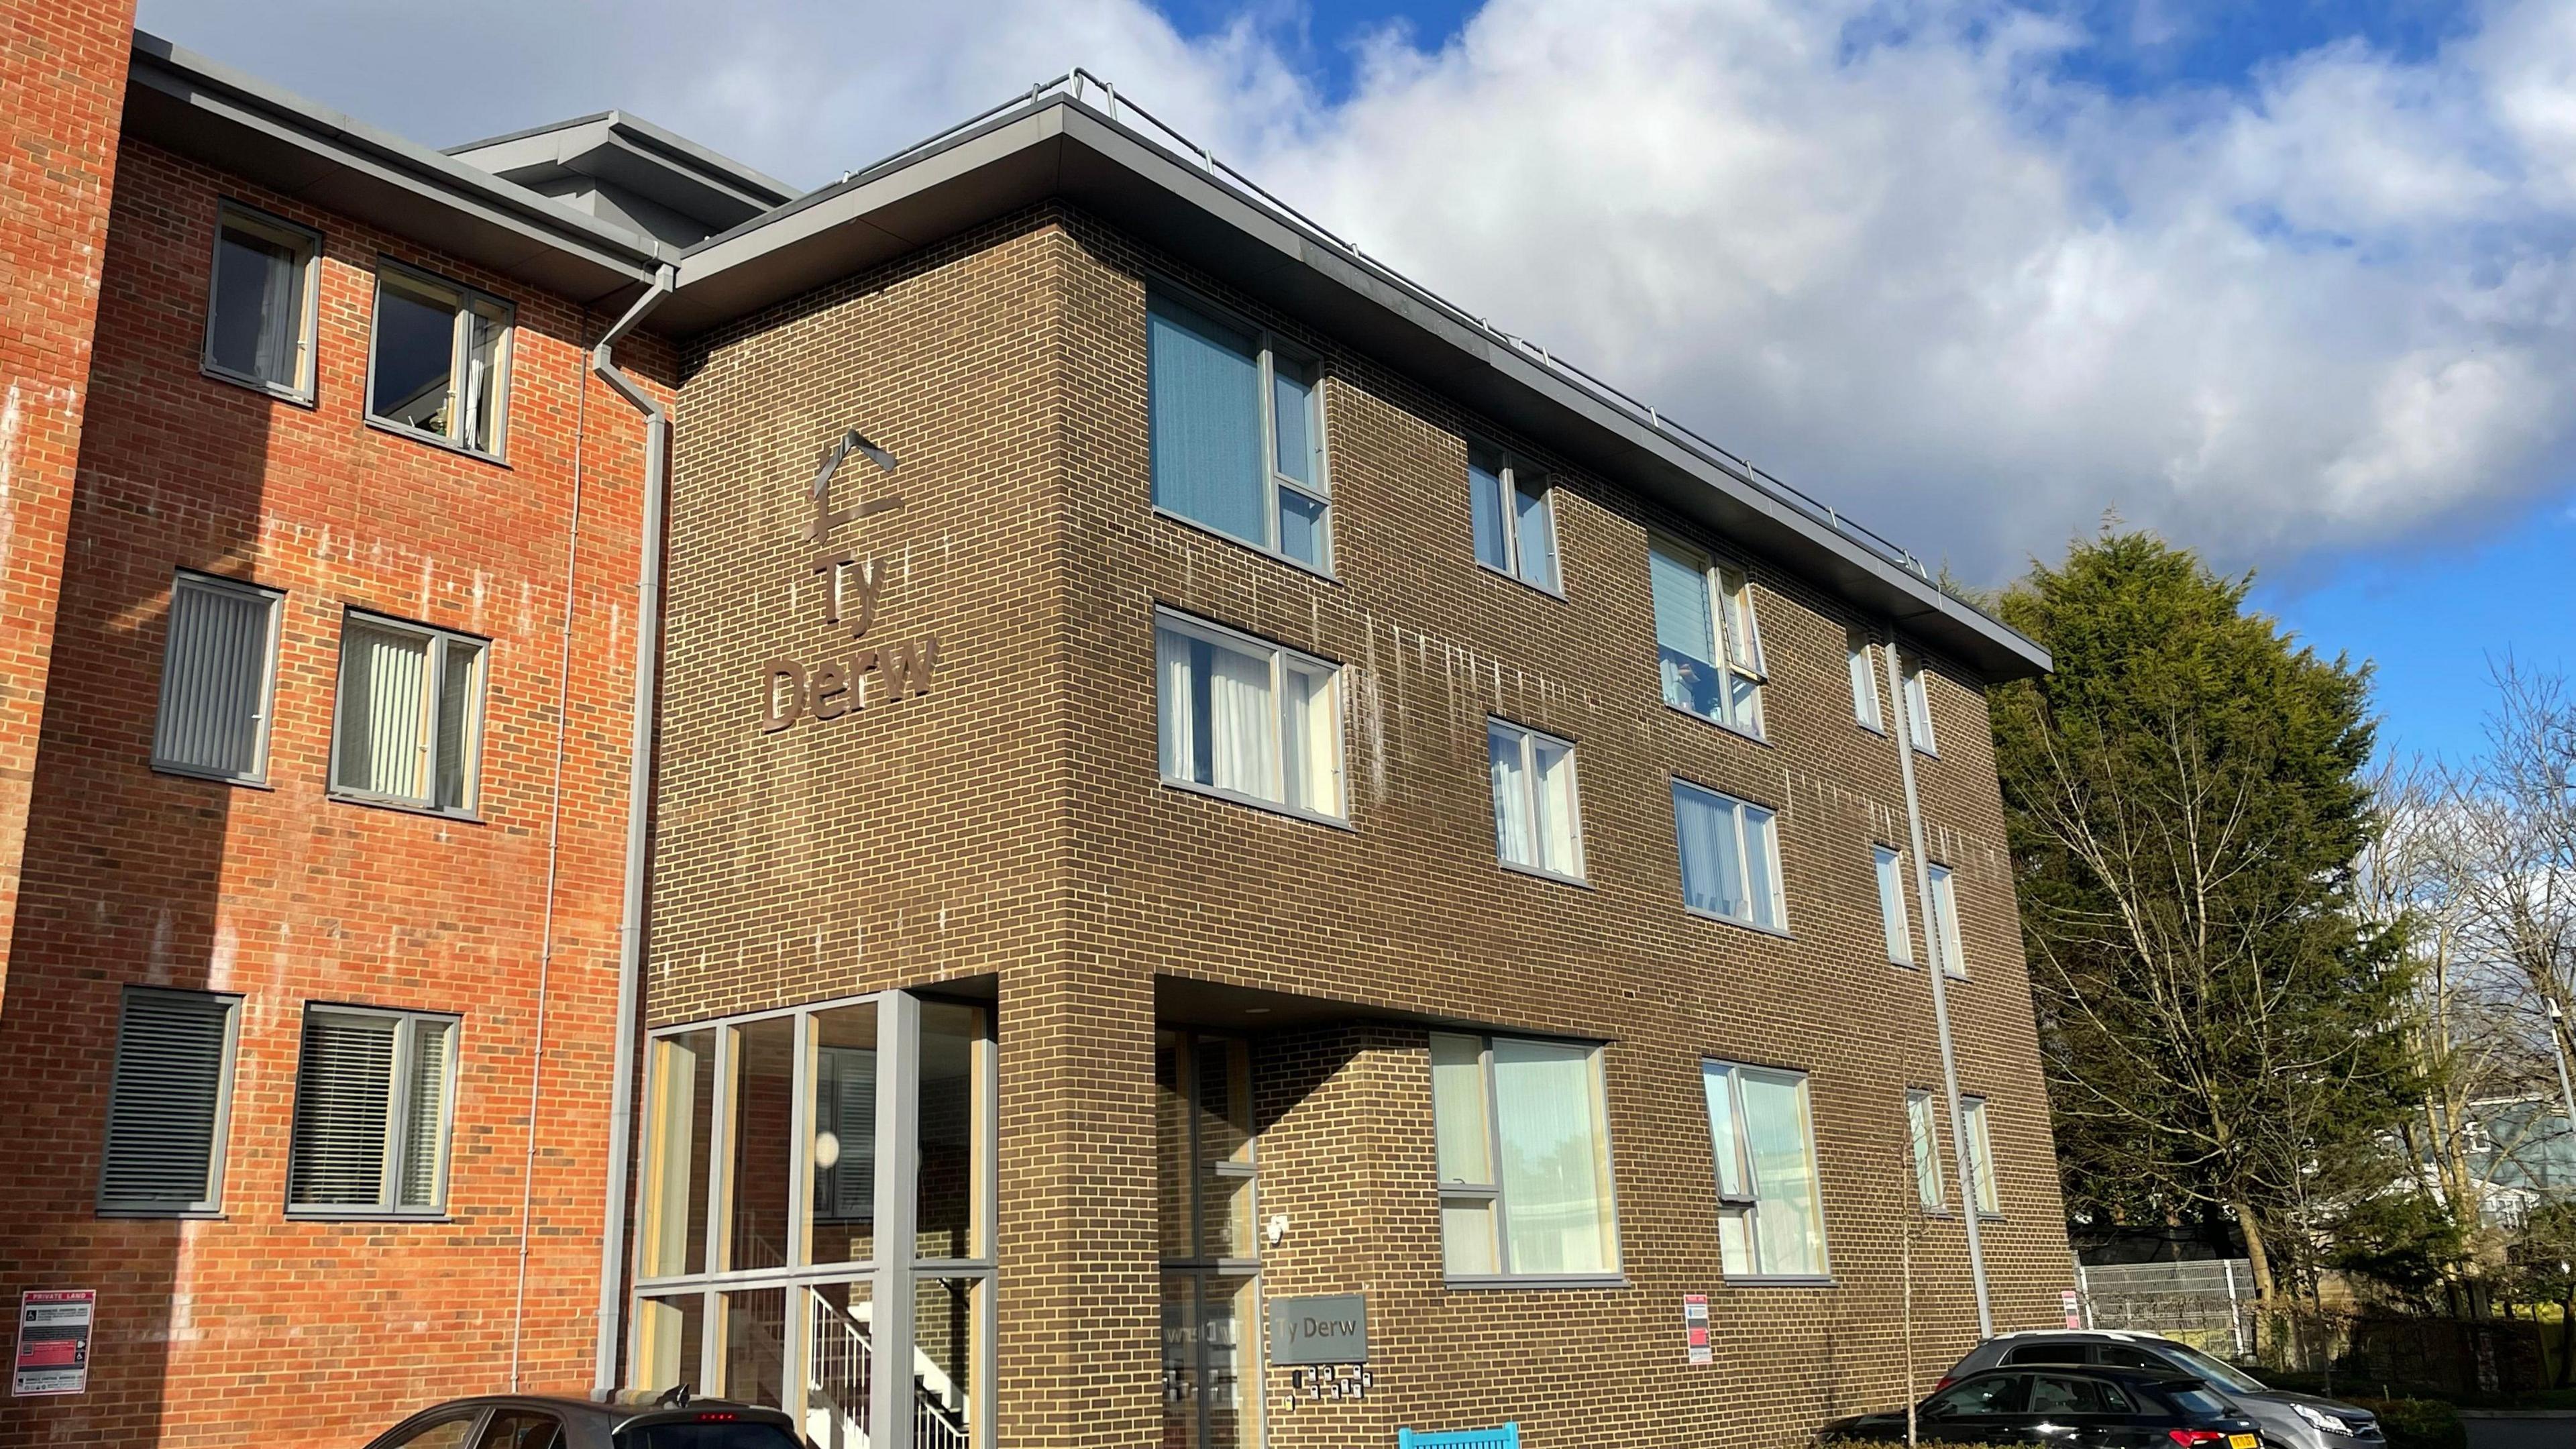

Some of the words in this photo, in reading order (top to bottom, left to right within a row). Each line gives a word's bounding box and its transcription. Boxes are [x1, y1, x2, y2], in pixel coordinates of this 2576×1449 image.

[813, 552, 888, 639] Ty
[763, 638, 940, 734] Derw
[1275, 1318, 1298, 1344] Ty
[1303, 1317, 1356, 1338] Derw
